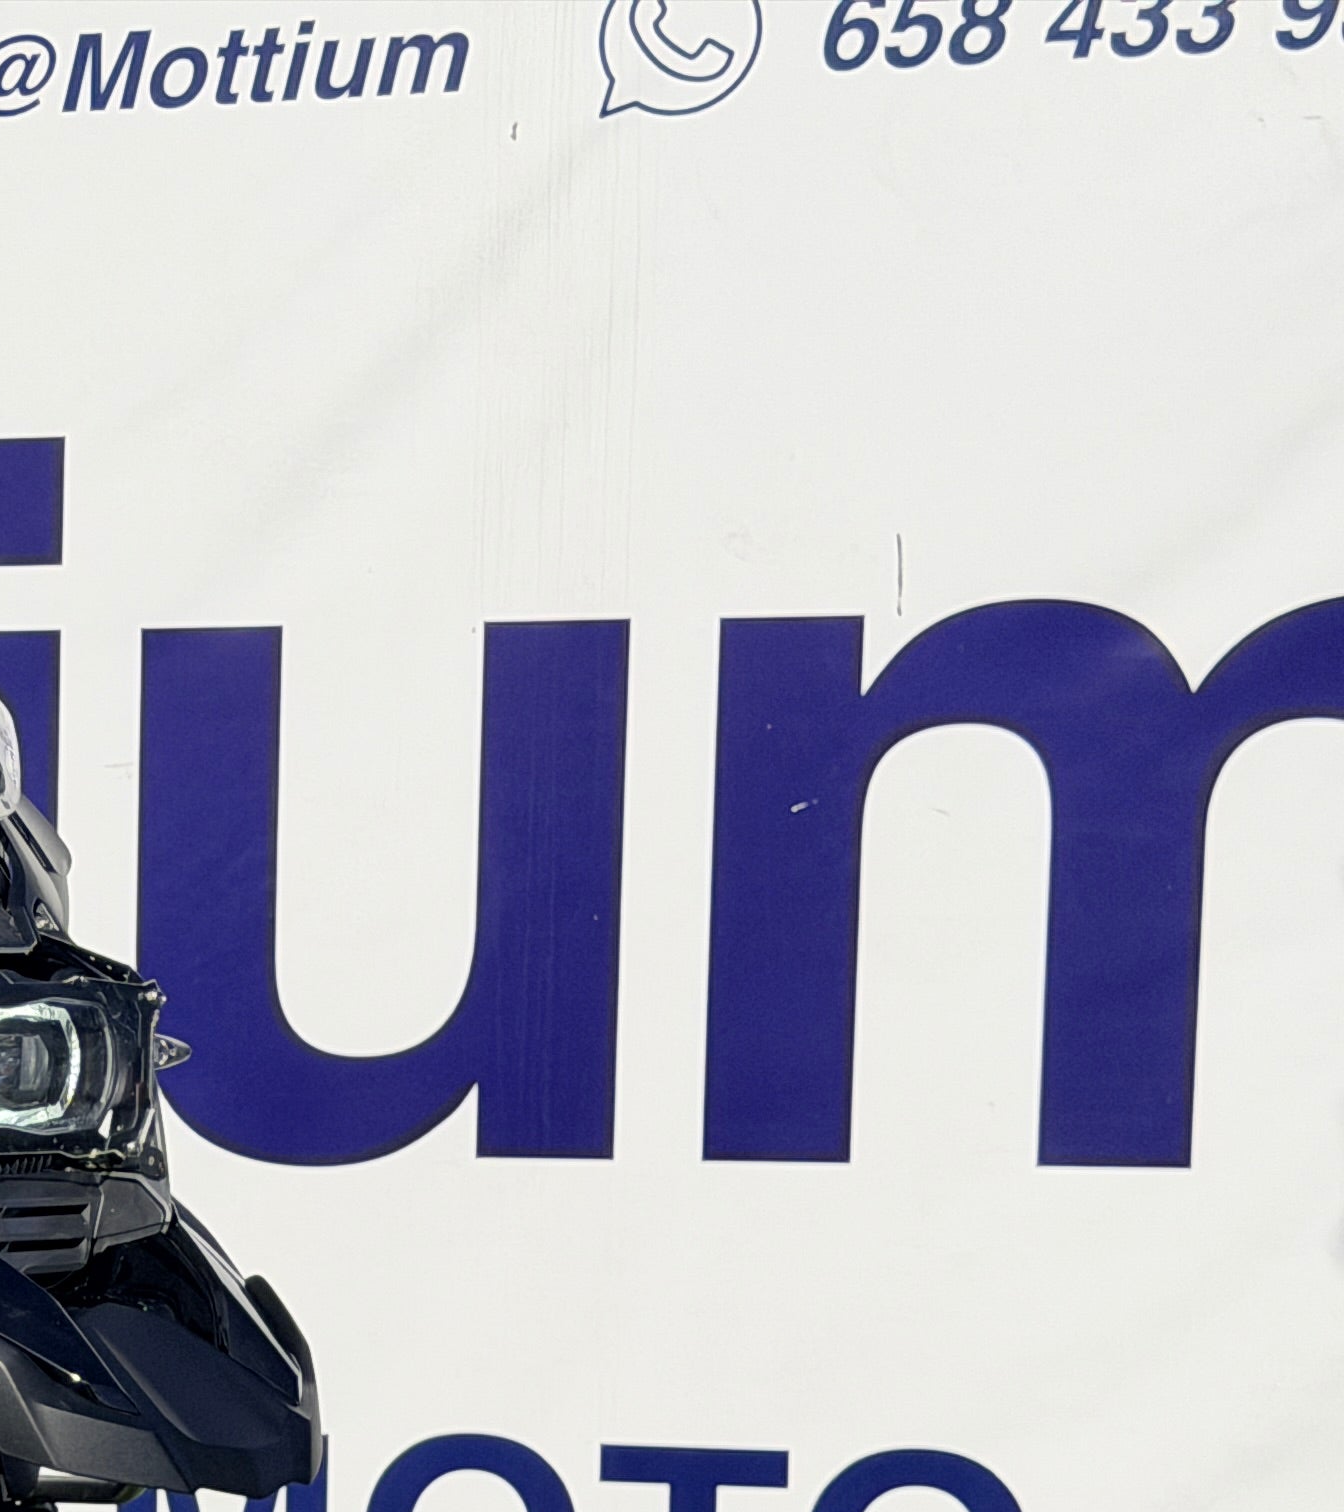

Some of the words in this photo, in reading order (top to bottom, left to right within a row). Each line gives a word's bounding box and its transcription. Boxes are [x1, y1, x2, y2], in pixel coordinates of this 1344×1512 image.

[823, 0, 1014, 71] 658
[1045, 0, 1236, 59] 433
[1276, 0, 1344, 51] 9
